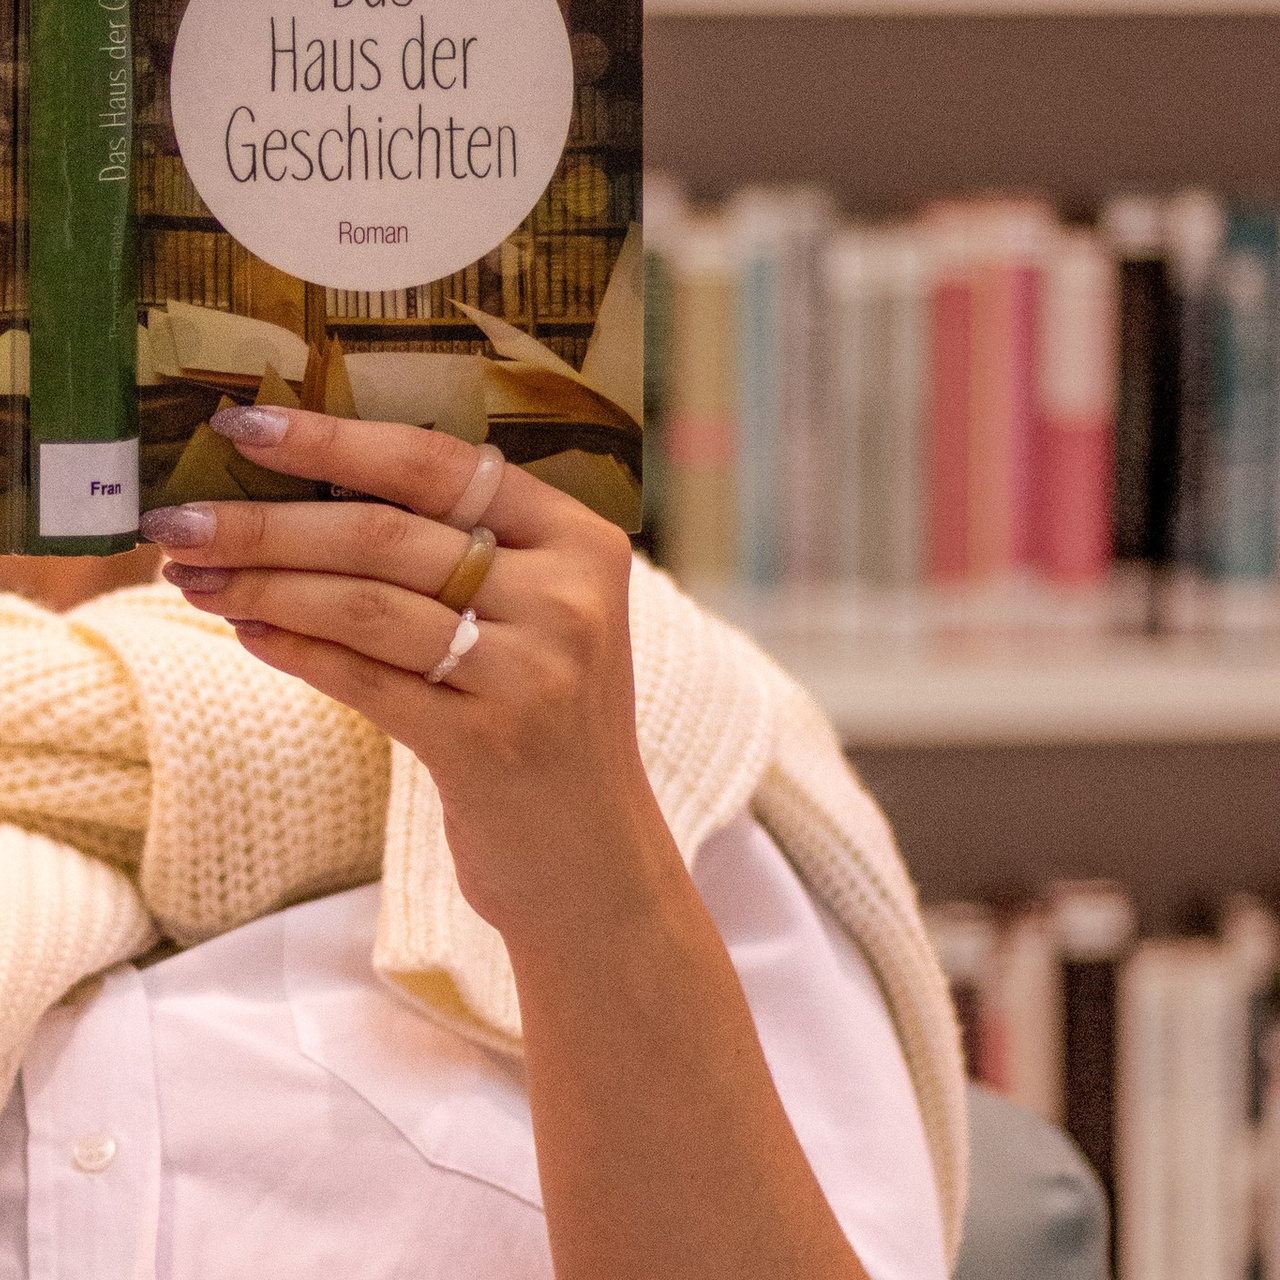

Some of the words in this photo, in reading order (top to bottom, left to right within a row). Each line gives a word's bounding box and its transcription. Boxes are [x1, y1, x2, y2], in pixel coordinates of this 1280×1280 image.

[99, 20, 127, 59] der
[270, 15, 382, 93] Haus
[402, 14, 478, 90] der
[99, 69, 127, 127] Haus
[99, 137, 127, 181] Das
[225, 103, 517, 183] Geschichten
[338, 220, 409, 245] Roman
[90, 481, 122, 496] Fran
